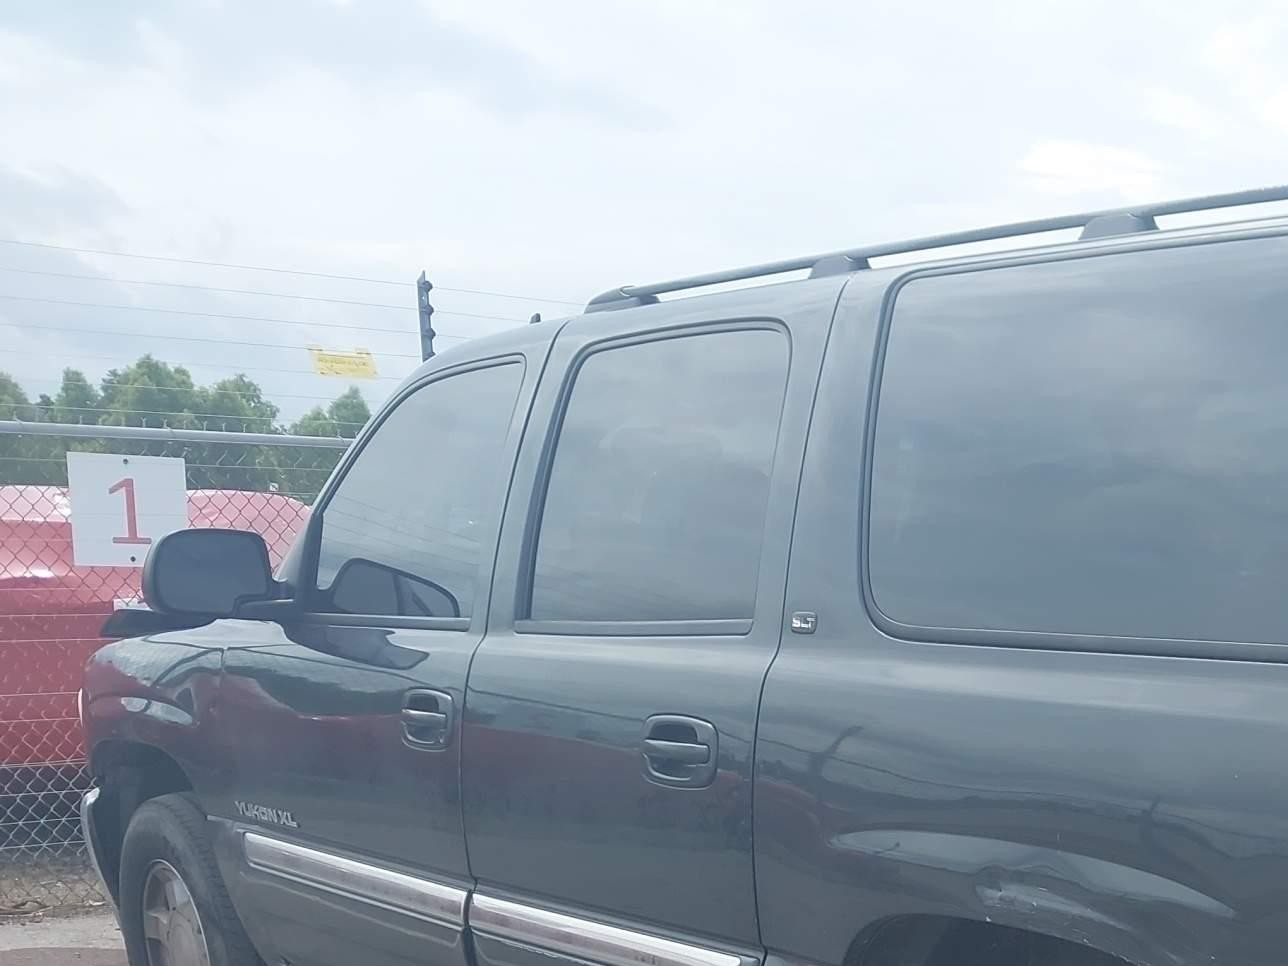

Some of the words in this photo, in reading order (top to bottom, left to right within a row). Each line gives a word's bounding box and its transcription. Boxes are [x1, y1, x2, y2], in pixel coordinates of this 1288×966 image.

[109, 478, 152, 544] 1
[234, 801, 278, 823] YUKON
[278, 810, 298, 828] XL
